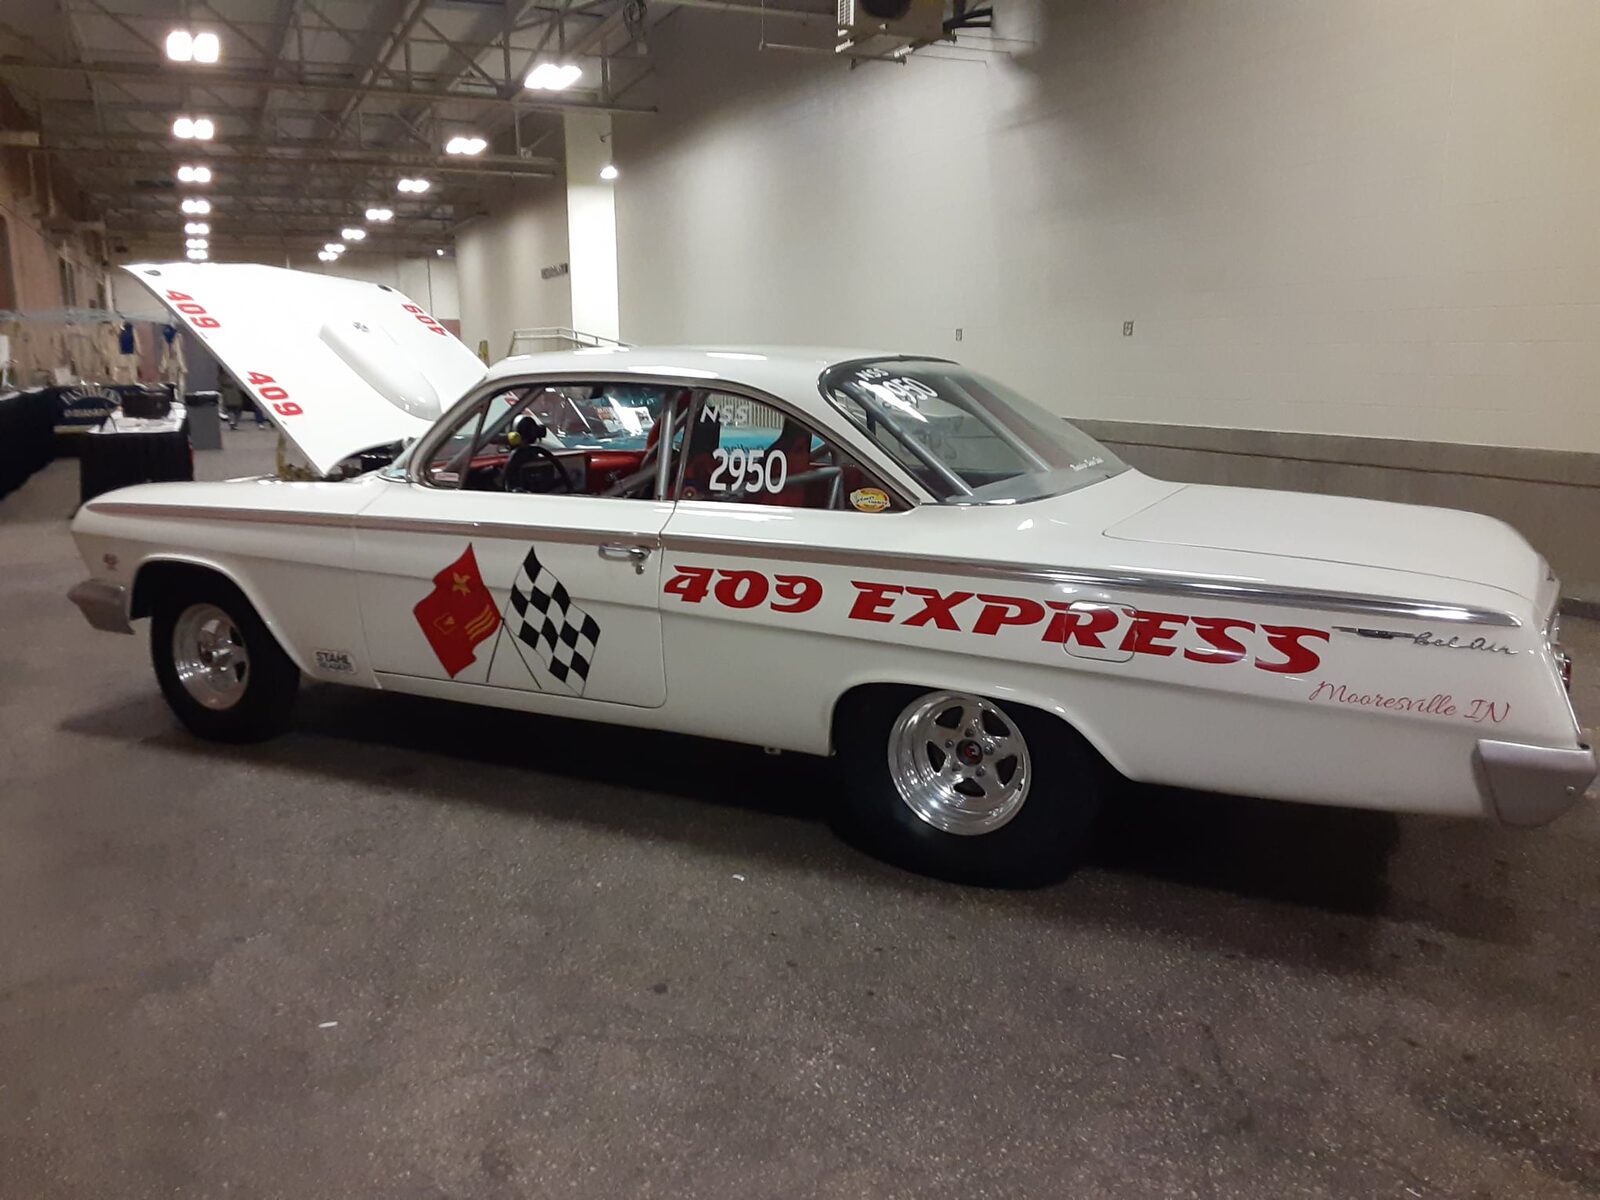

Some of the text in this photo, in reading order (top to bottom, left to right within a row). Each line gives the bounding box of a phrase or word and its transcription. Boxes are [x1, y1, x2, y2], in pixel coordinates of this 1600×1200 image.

[167, 290, 221, 329] 409
[401, 304, 447, 336] 409
[249, 371, 304, 417] 409
[700, 404, 748, 425] NSS
[709, 448, 788, 494] 2950
[663, 565, 1331, 675] 409 EXPRESS
[1413, 631, 1518, 655] Bel Air
[1308, 680, 1511, 723] Mooresville IN
